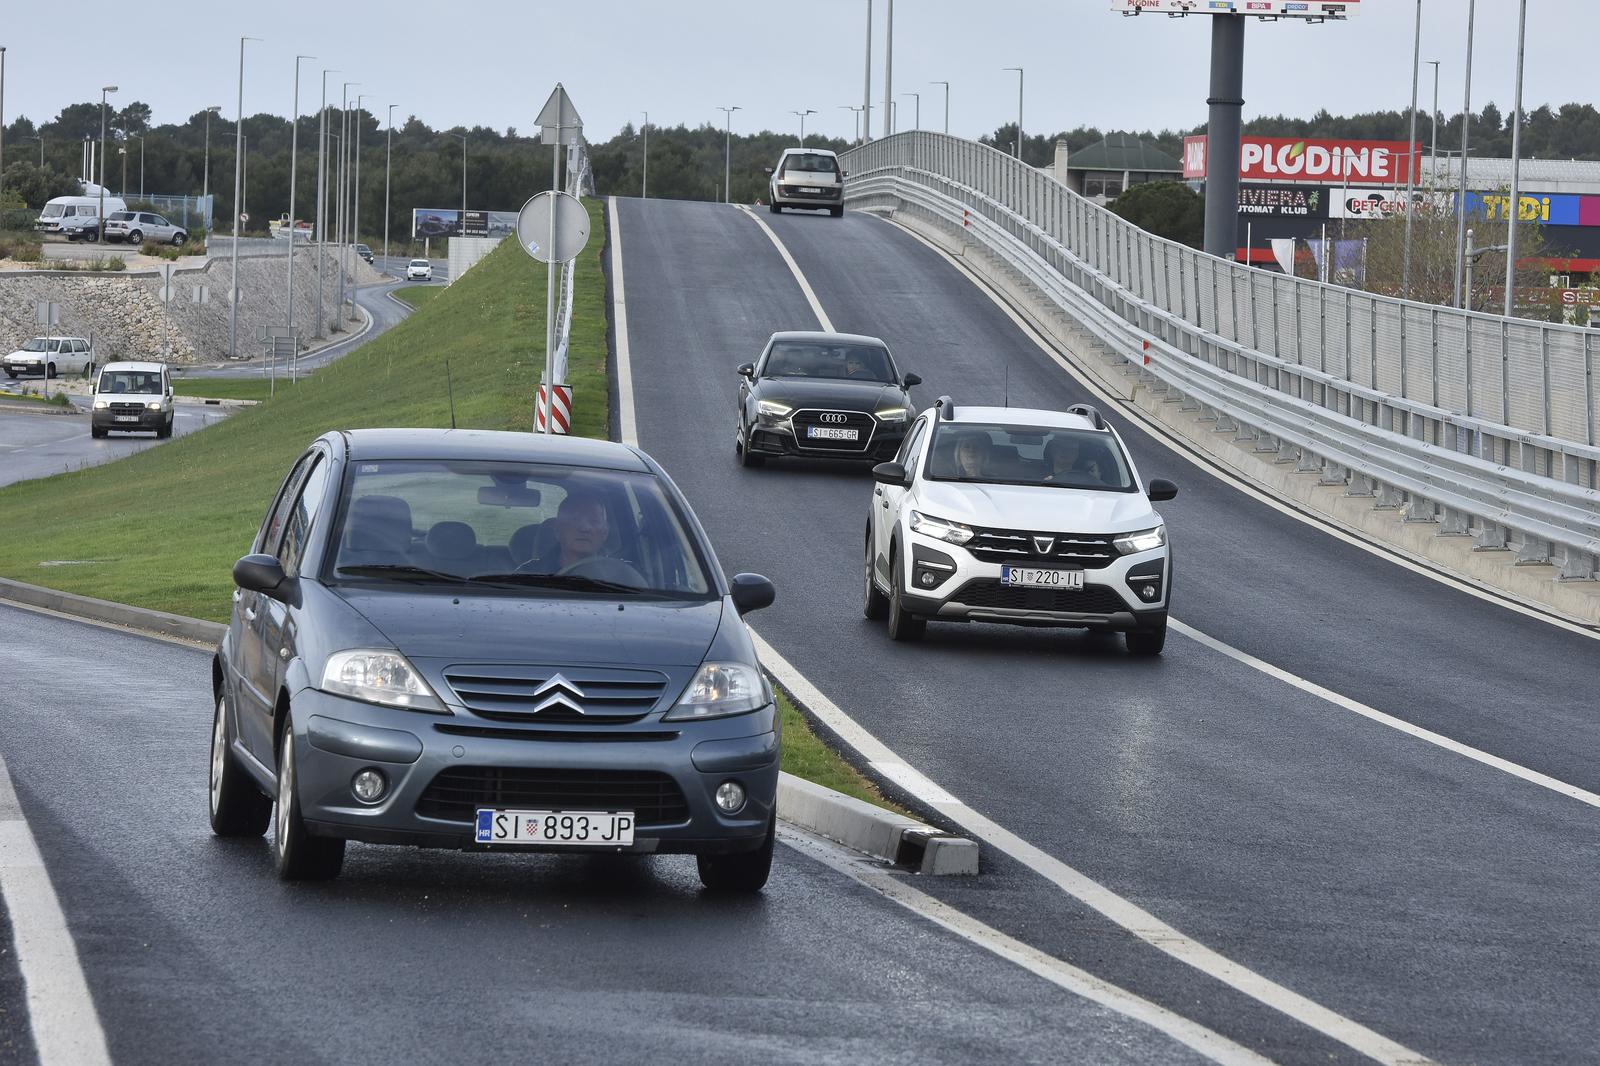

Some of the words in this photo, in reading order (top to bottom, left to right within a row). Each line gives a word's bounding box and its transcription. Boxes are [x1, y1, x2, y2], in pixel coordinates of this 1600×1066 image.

[1241, 142, 1389, 177] PLODINE
[1238, 189, 1307, 206] IVIERA
[1351, 199, 1377, 212] PET
[1281, 206, 1308, 215] KLUB
[828, 429, 857, 439] 665-GR
[1035, 570, 1080, 586] 220-IL
[478, 829, 491, 837] HR
[543, 815, 631, 841] 893-JP
